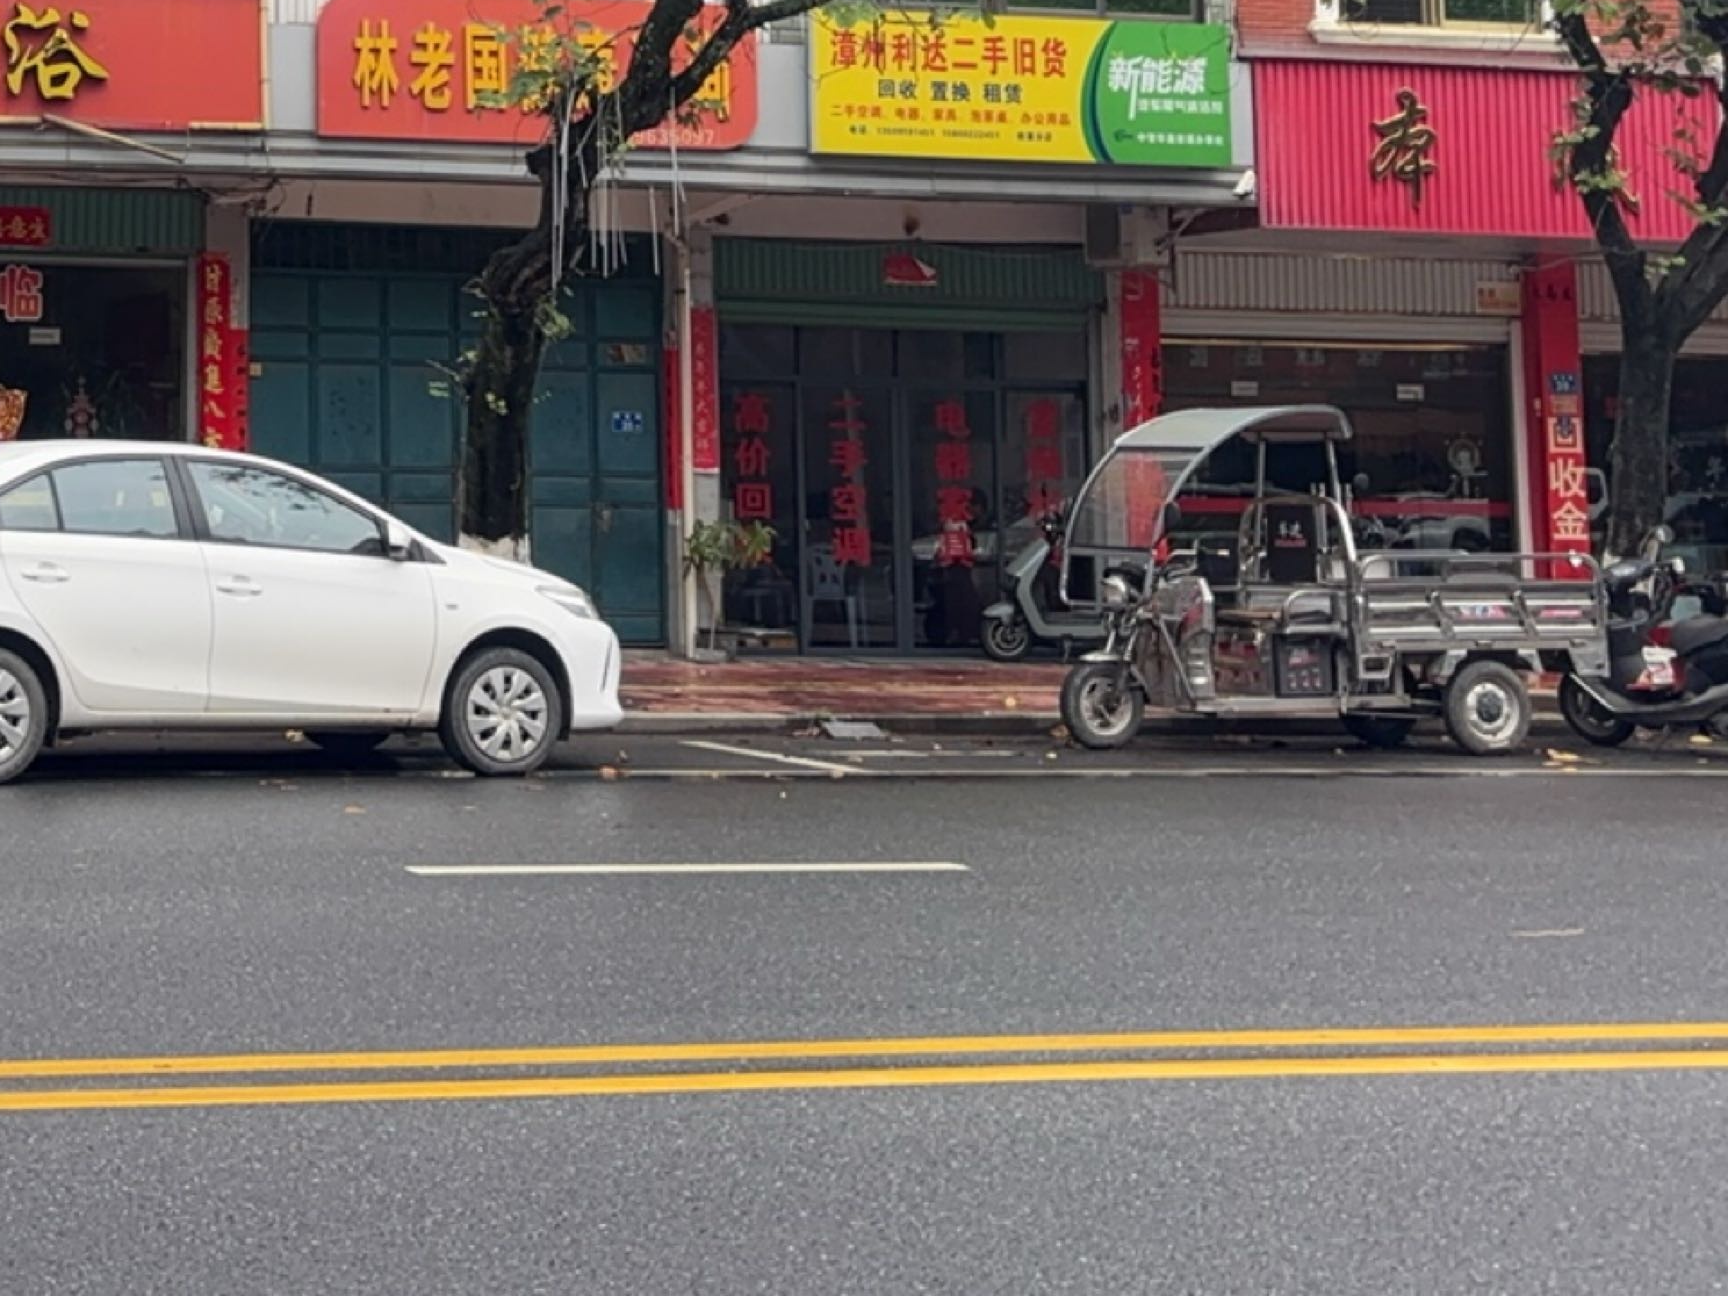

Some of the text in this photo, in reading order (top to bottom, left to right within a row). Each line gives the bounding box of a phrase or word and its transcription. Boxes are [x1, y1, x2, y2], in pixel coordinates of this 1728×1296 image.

[830, 29, 1068, 78] 漳州利达二手旧货
[1108, 55, 1208, 121] 新能源
